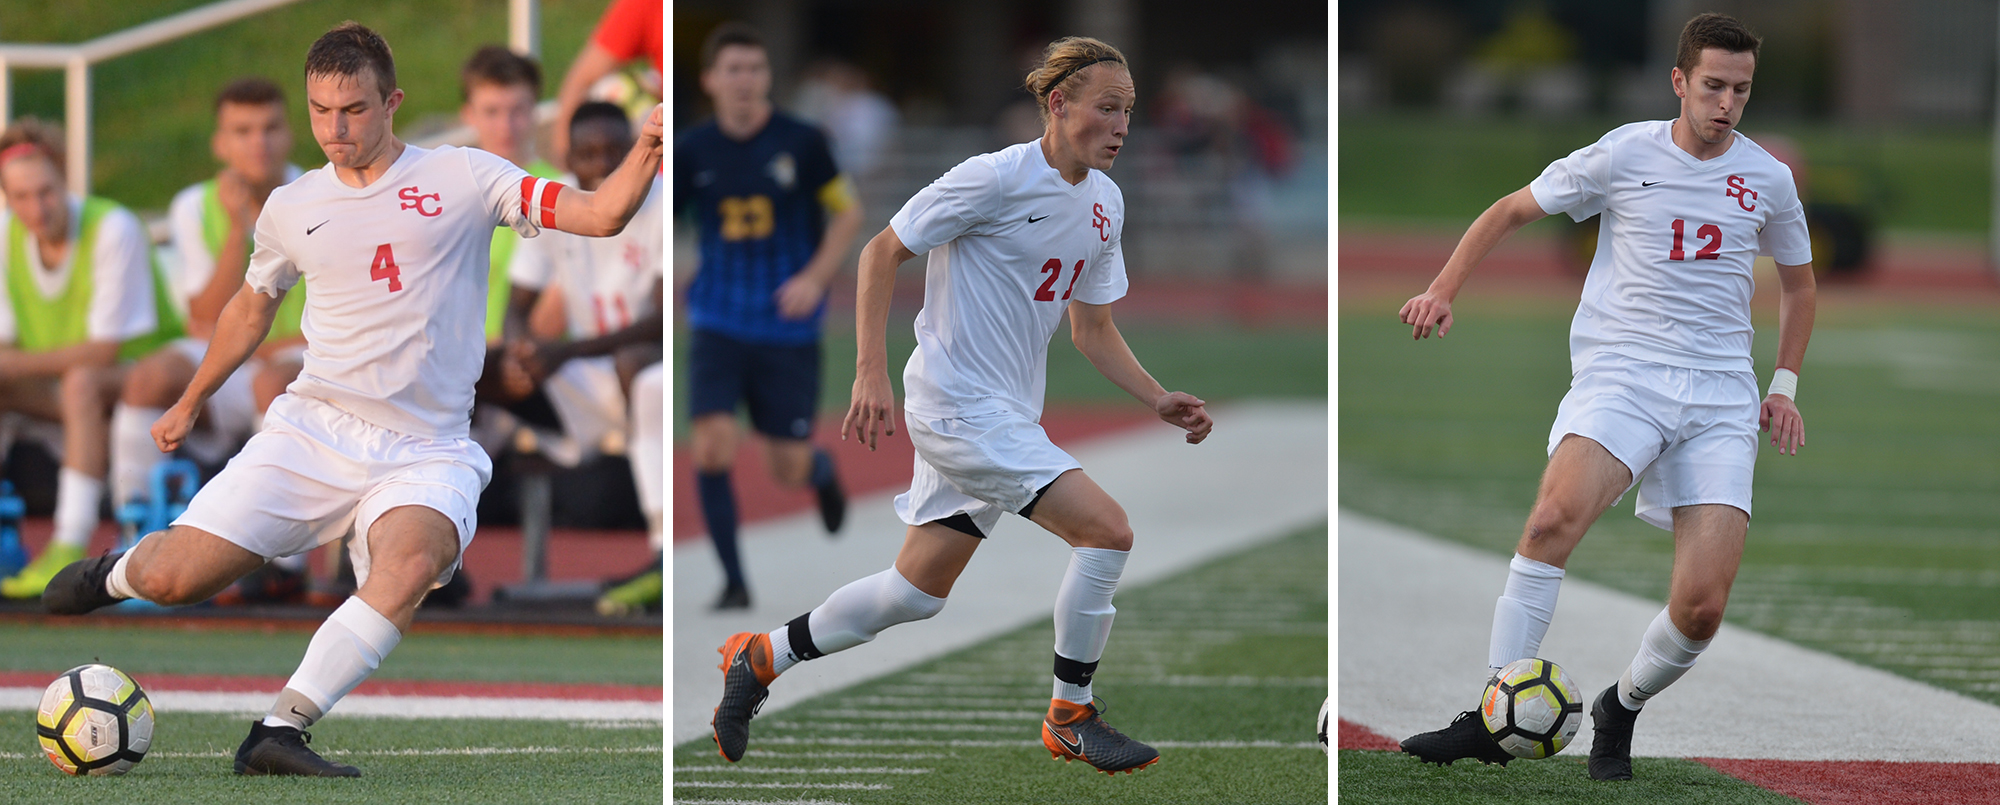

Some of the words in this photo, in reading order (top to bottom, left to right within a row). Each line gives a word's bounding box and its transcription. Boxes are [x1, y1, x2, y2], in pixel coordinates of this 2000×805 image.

[398, 186, 443, 217] SC
[1726, 174, 1758, 212] SC
[1092, 202, 1111, 242] SC
[1669, 218, 1723, 261] 12
[370, 243, 403, 293] 4
[1033, 258, 1085, 302] 21
